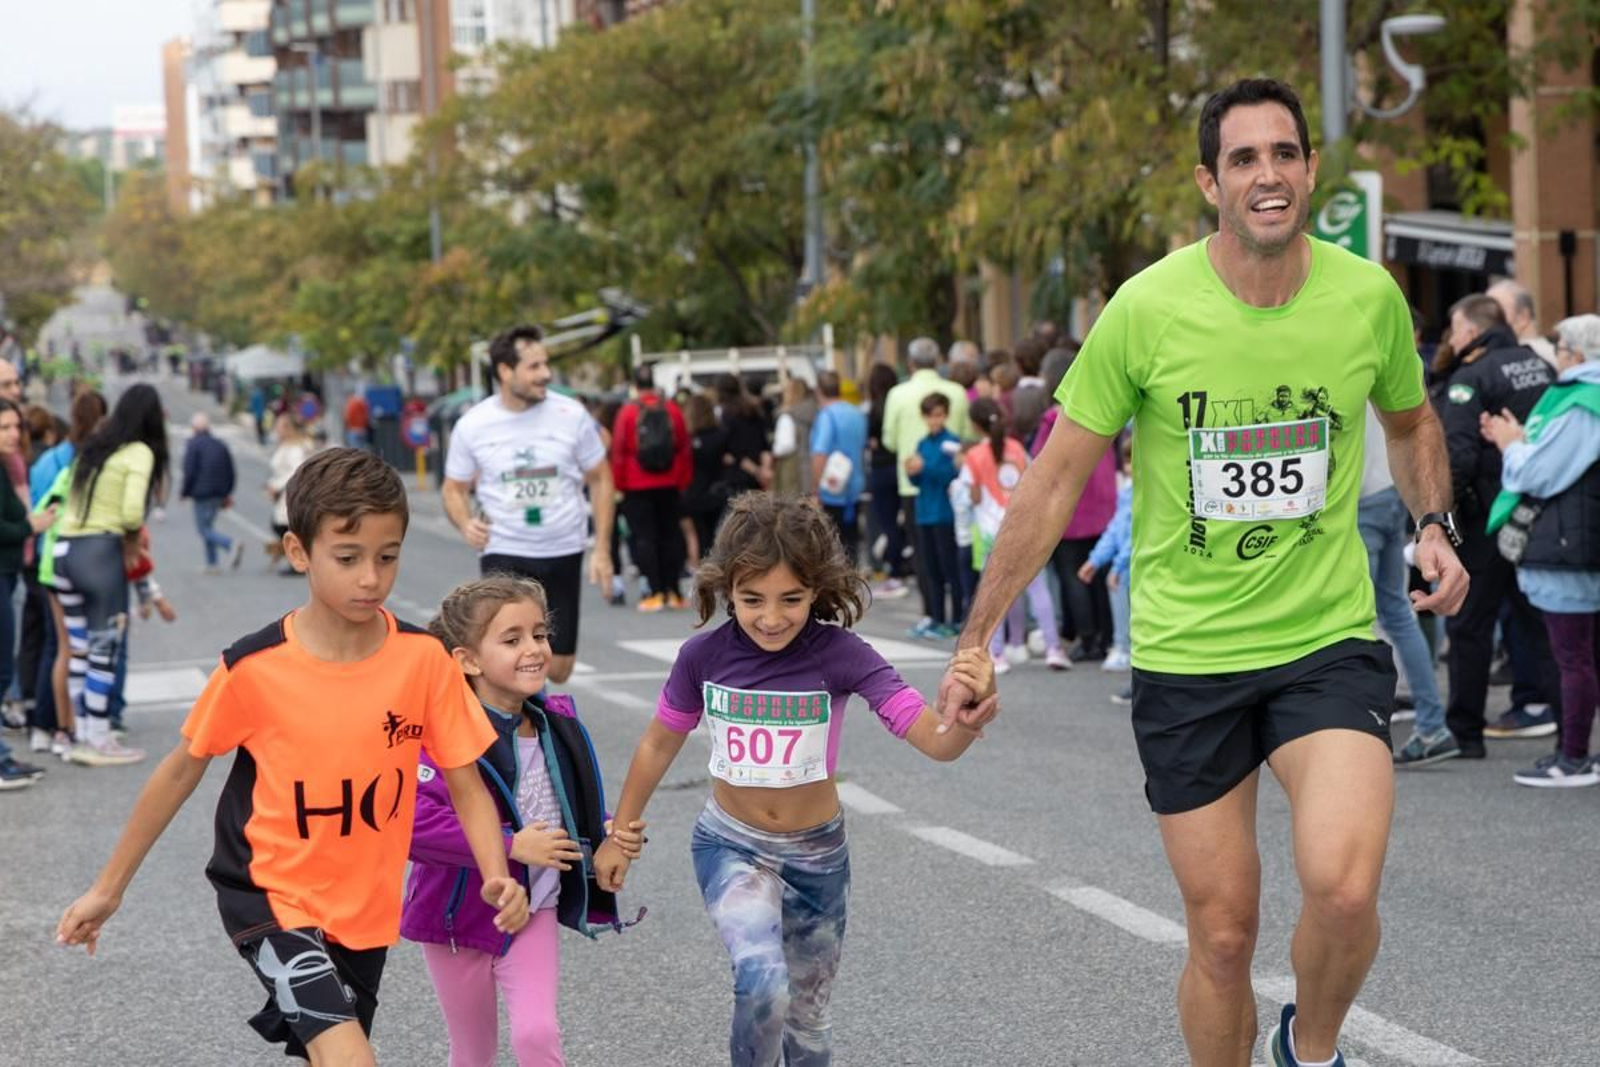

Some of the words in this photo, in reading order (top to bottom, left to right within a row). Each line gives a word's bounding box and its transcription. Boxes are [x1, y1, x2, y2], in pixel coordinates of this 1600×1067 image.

[1177, 391, 1207, 429] 17
[514, 481, 549, 499] 202
[1221, 457, 1304, 498] 385
[726, 726, 803, 766] 607
